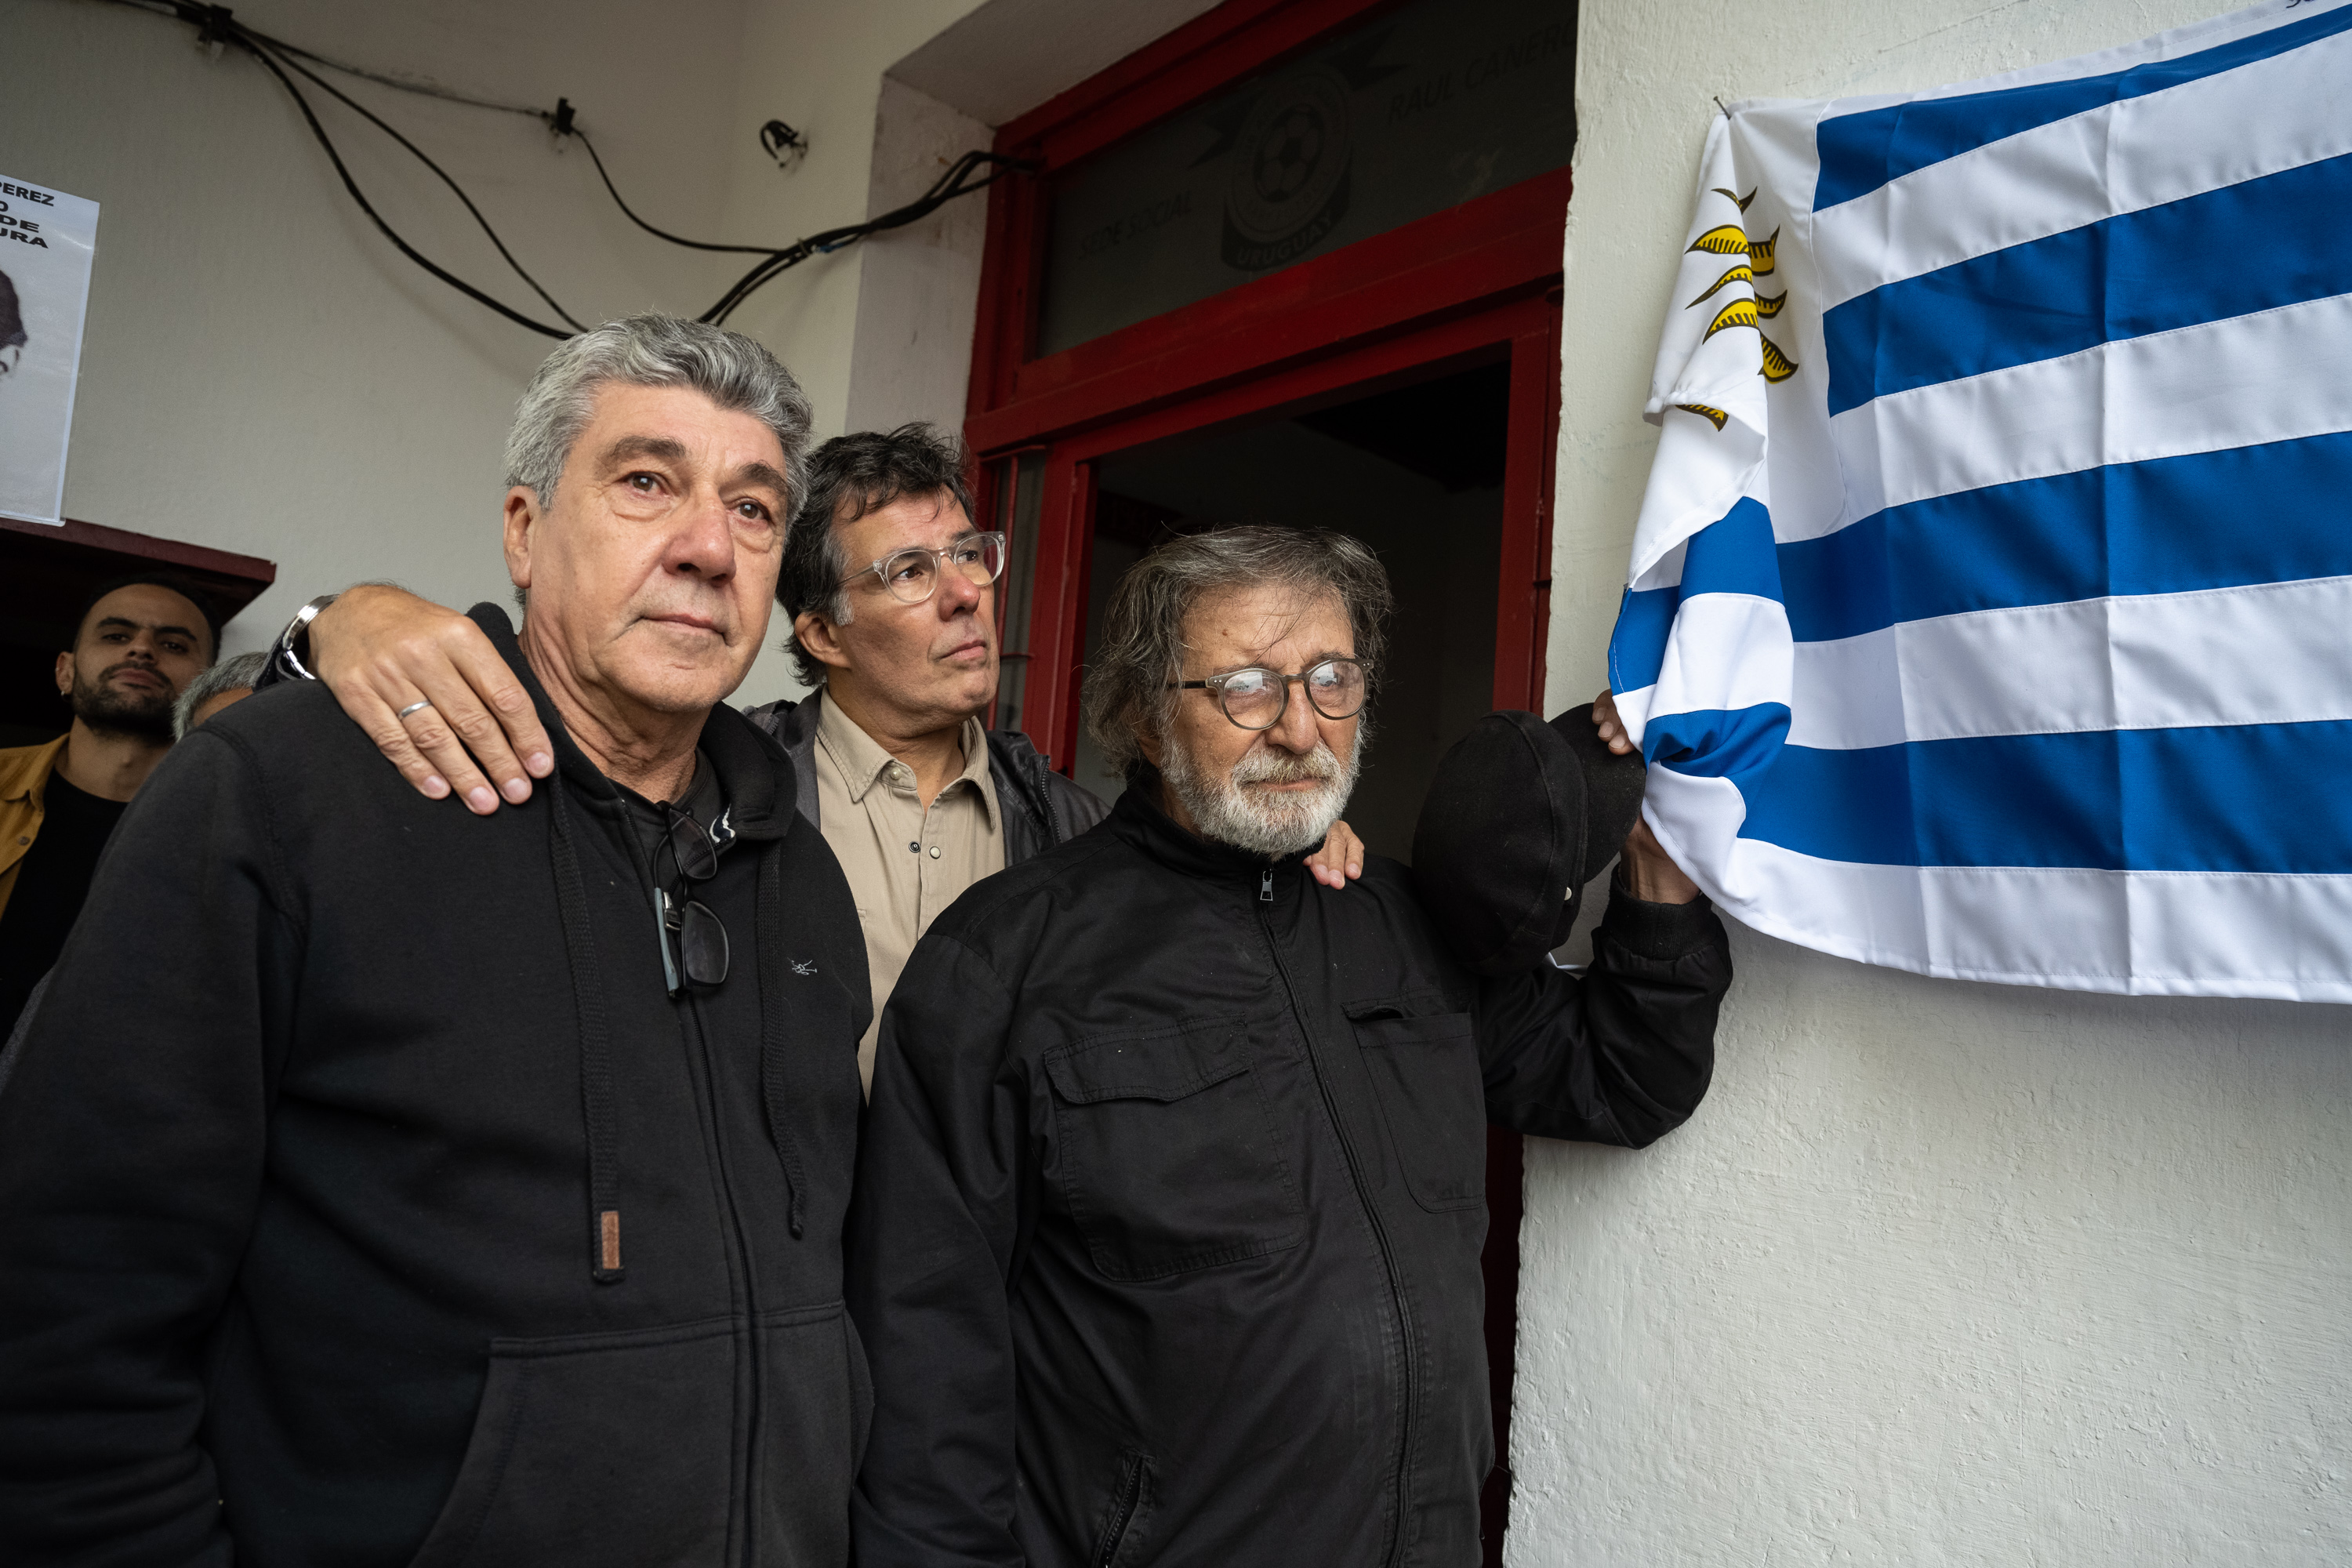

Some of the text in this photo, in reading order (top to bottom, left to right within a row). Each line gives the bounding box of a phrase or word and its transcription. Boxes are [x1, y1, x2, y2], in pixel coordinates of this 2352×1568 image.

[1388, 72, 1454, 126] RAUL
[0, 182, 54, 207] EREZ
[1236, 209, 1331, 265] URUGUAY
